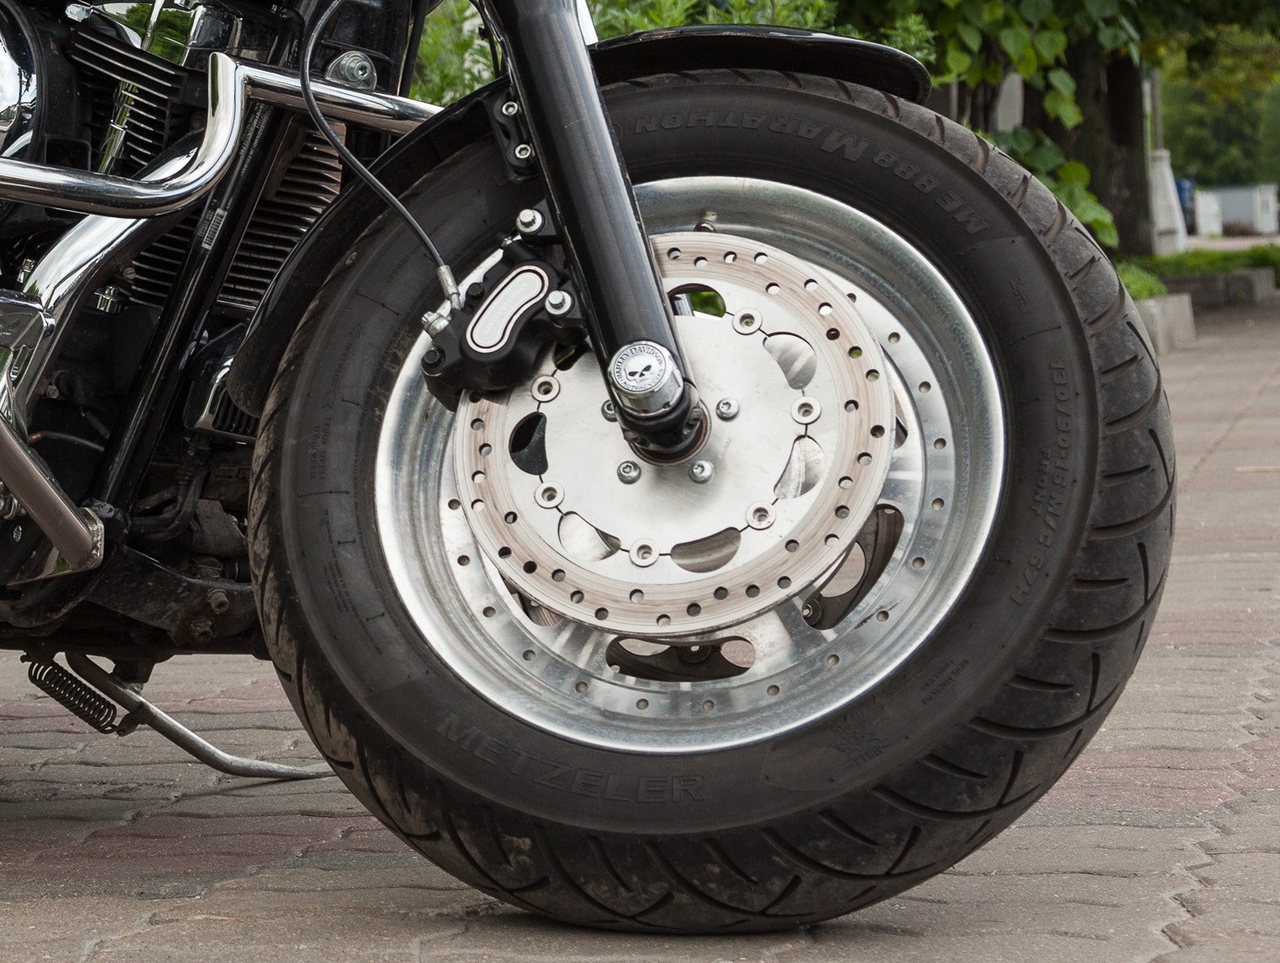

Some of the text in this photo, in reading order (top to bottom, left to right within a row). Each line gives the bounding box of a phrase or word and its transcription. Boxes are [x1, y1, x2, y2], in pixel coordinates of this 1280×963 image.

[872, 149, 942, 194] 888
[934, 192, 991, 235] ME
[1030, 448, 1051, 516] FRONT
[436, 709, 707, 804] METZELER
